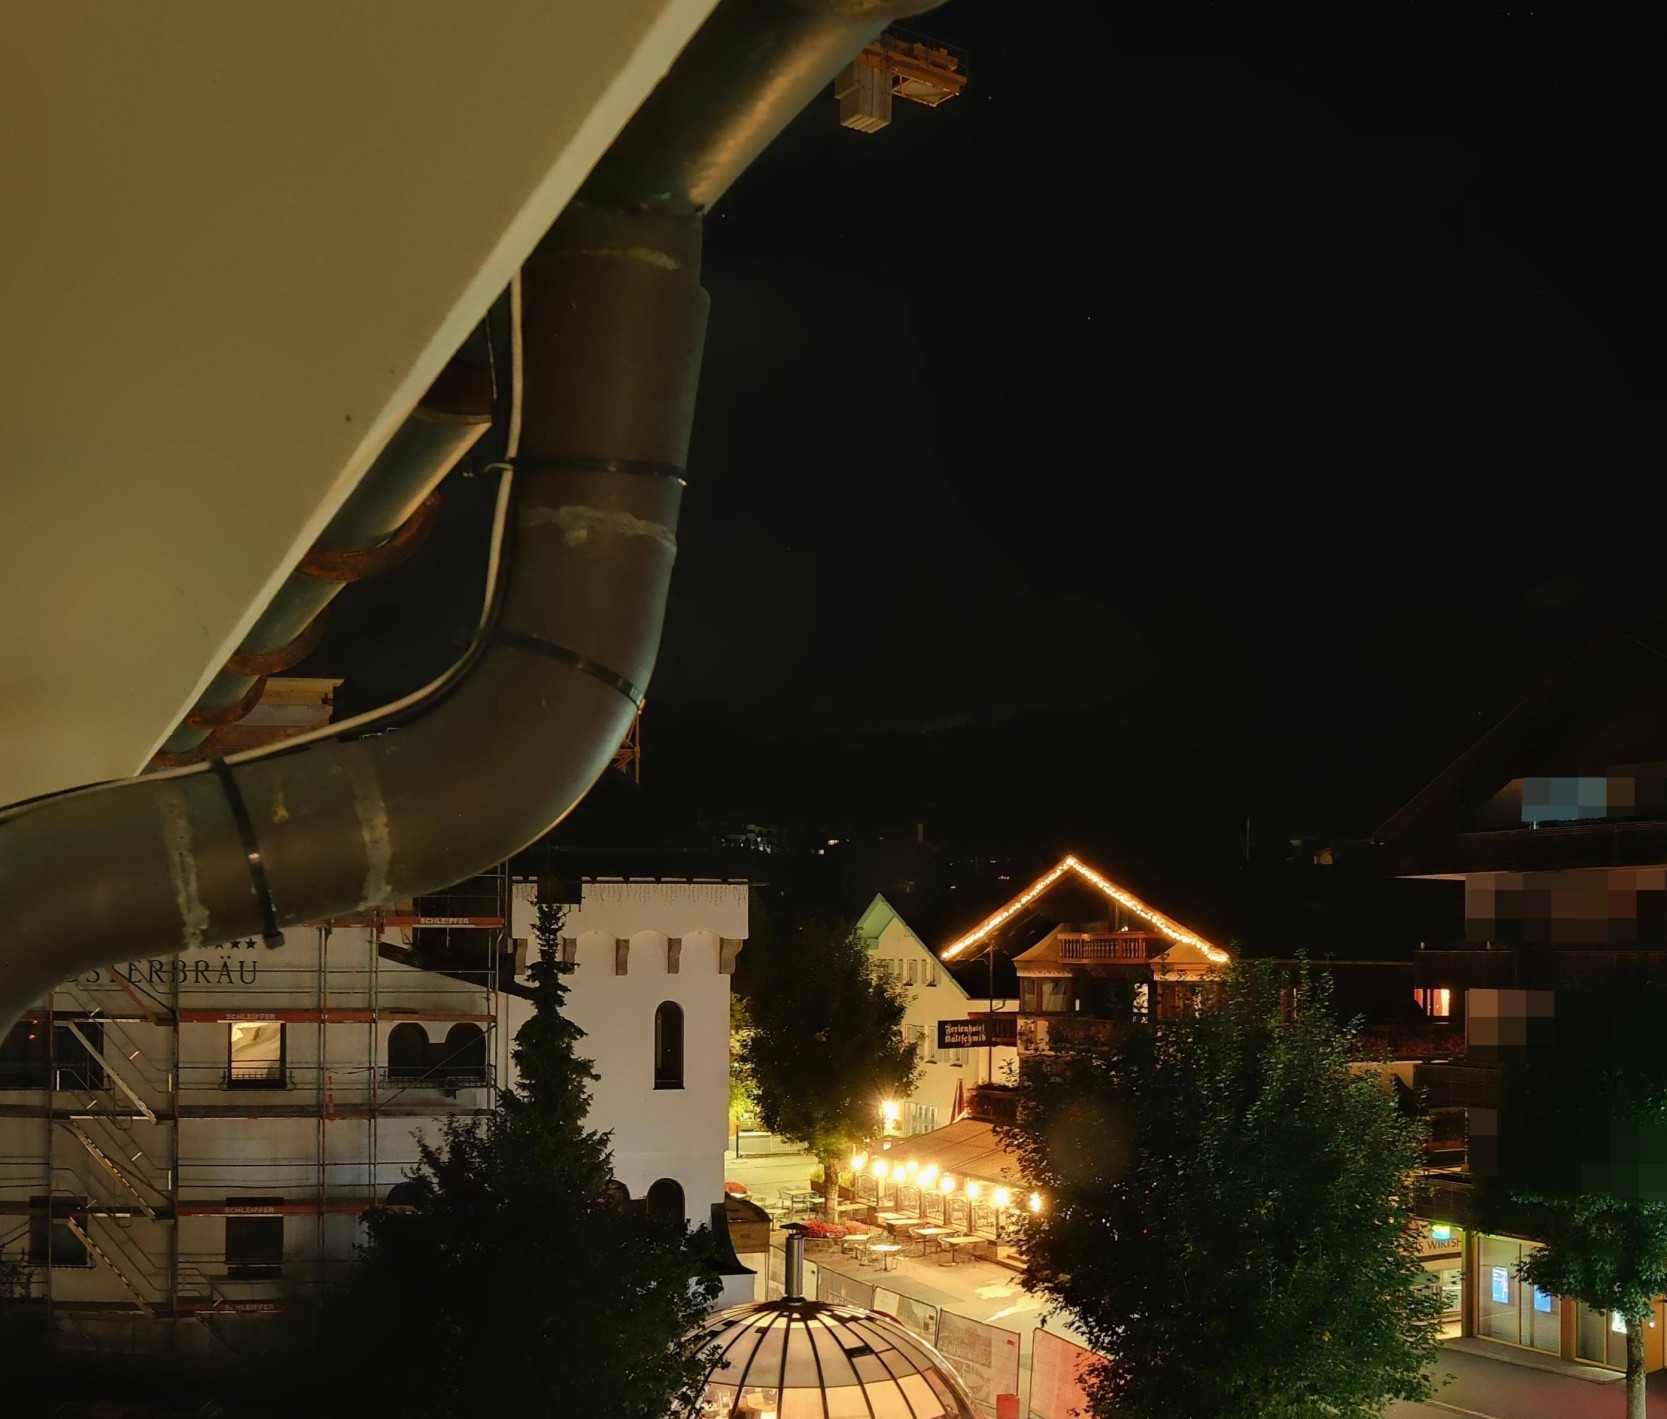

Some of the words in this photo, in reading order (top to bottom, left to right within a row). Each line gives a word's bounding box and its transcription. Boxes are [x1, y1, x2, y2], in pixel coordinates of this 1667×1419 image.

[420, 917, 469, 925] SCHLEIPFER
[65, 955, 258, 985] SERBRÄU
[225, 1013, 276, 1021] SCHLEIPFER
[224, 1206, 275, 1214] SCHLEIPFER
